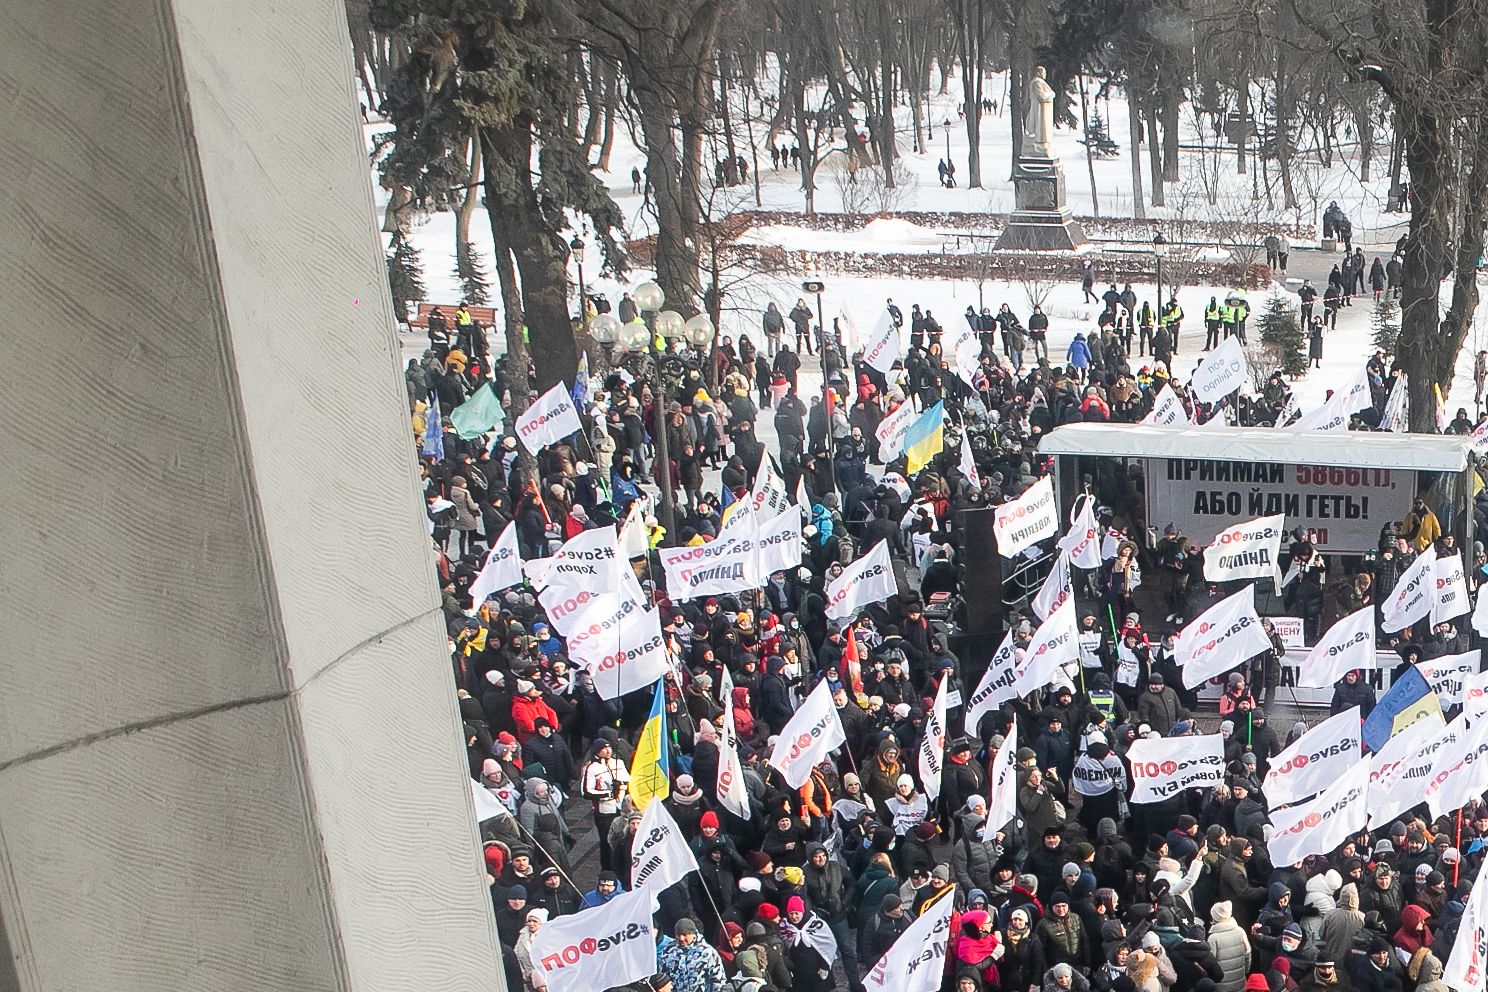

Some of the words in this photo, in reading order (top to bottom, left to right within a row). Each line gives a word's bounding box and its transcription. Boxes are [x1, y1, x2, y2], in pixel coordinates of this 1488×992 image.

[1193, 490, 1242, 515] АБО
[1249, 488, 1299, 517] ЙДИ
[1306, 494, 1369, 520] ГЕТЬ!
